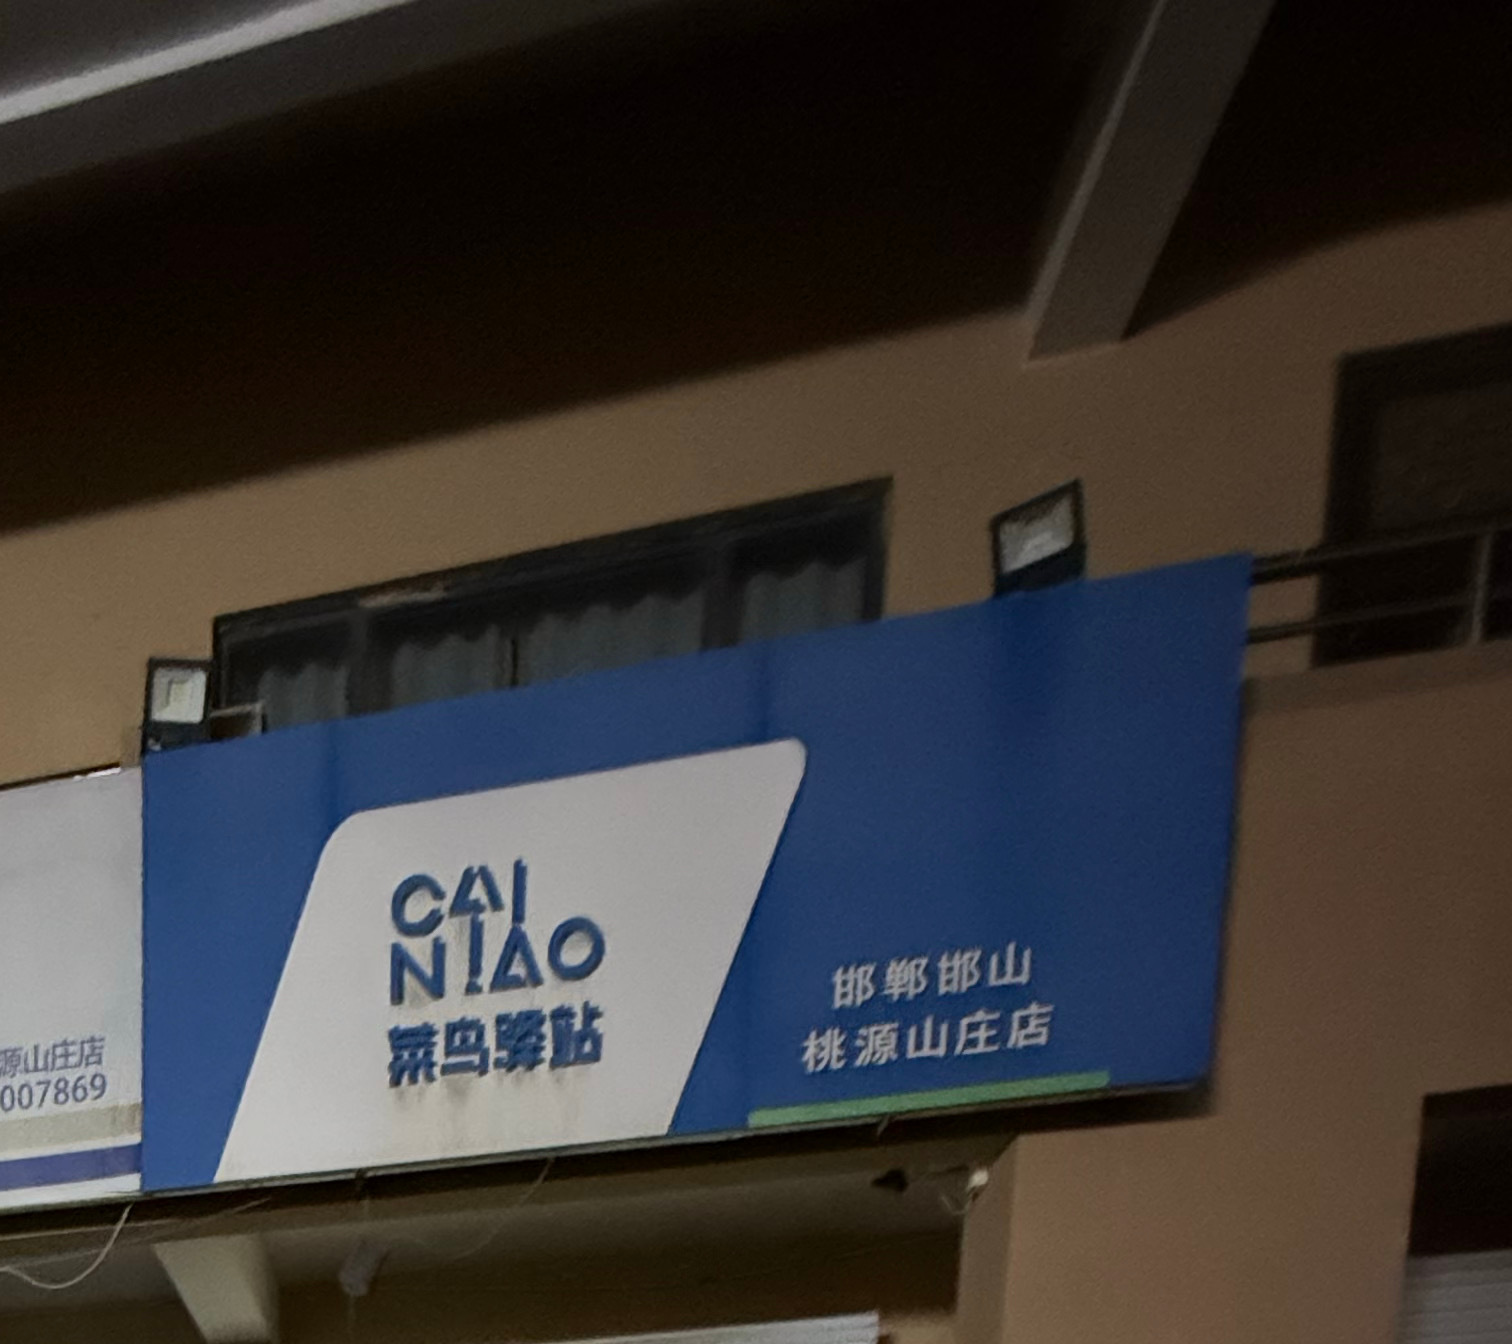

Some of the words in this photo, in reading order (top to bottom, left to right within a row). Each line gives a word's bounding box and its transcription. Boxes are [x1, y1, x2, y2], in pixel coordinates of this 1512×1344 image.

[391, 857, 528, 937] CAI
[390, 914, 606, 1006] NIAO
[831, 941, 1033, 1010] 邯郸邯山
[388, 1001, 604, 1088] 菜鸟驿站
[801, 1001, 1055, 1074] 桃源山庄店
